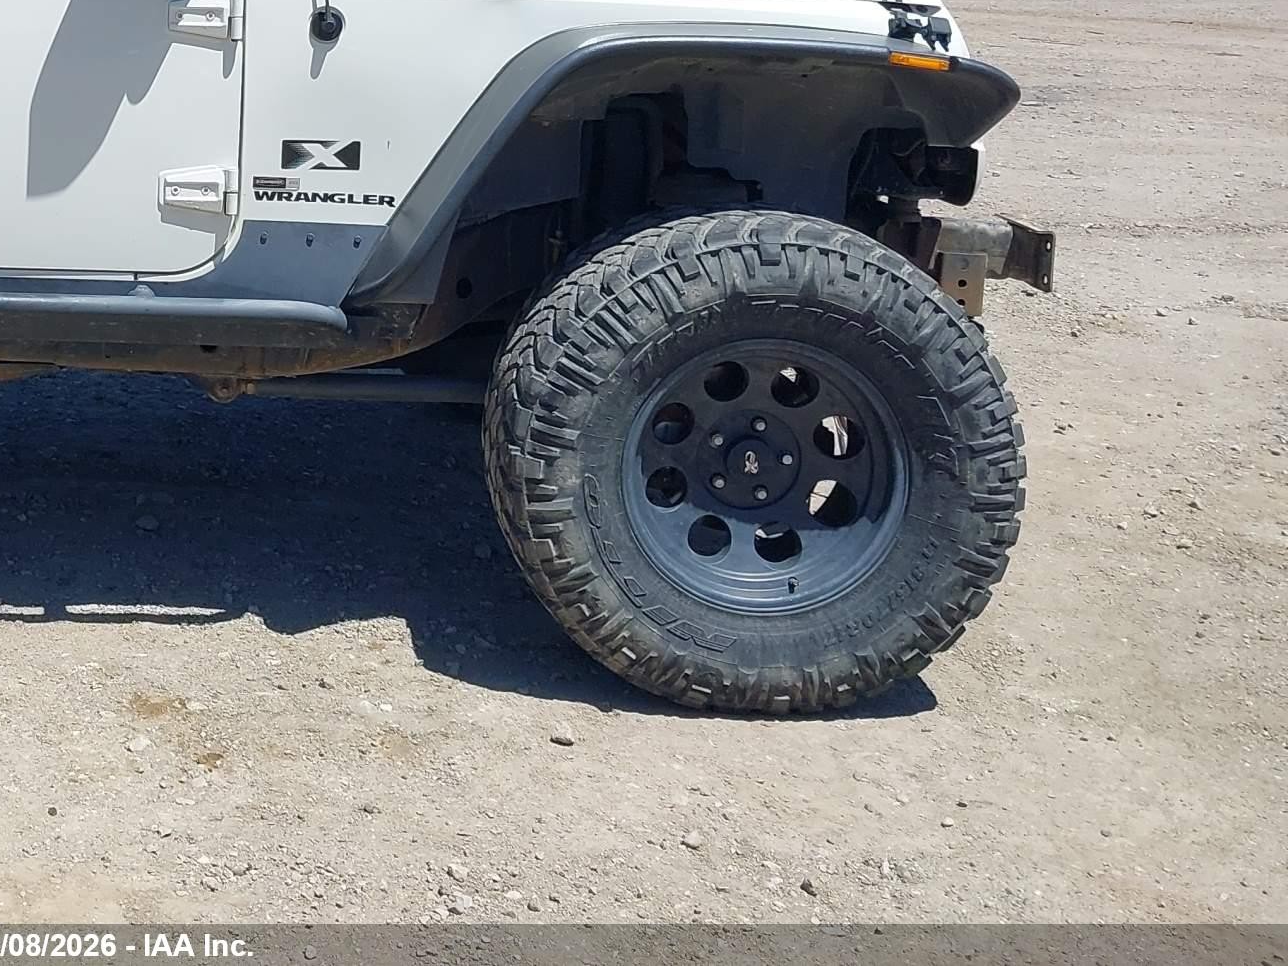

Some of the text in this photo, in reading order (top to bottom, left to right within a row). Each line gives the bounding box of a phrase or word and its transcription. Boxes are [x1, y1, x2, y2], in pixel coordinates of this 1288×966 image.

[285, 140, 358, 170] X
[253, 190, 396, 208] WRANGLER
[582, 473, 738, 654] NITTO
